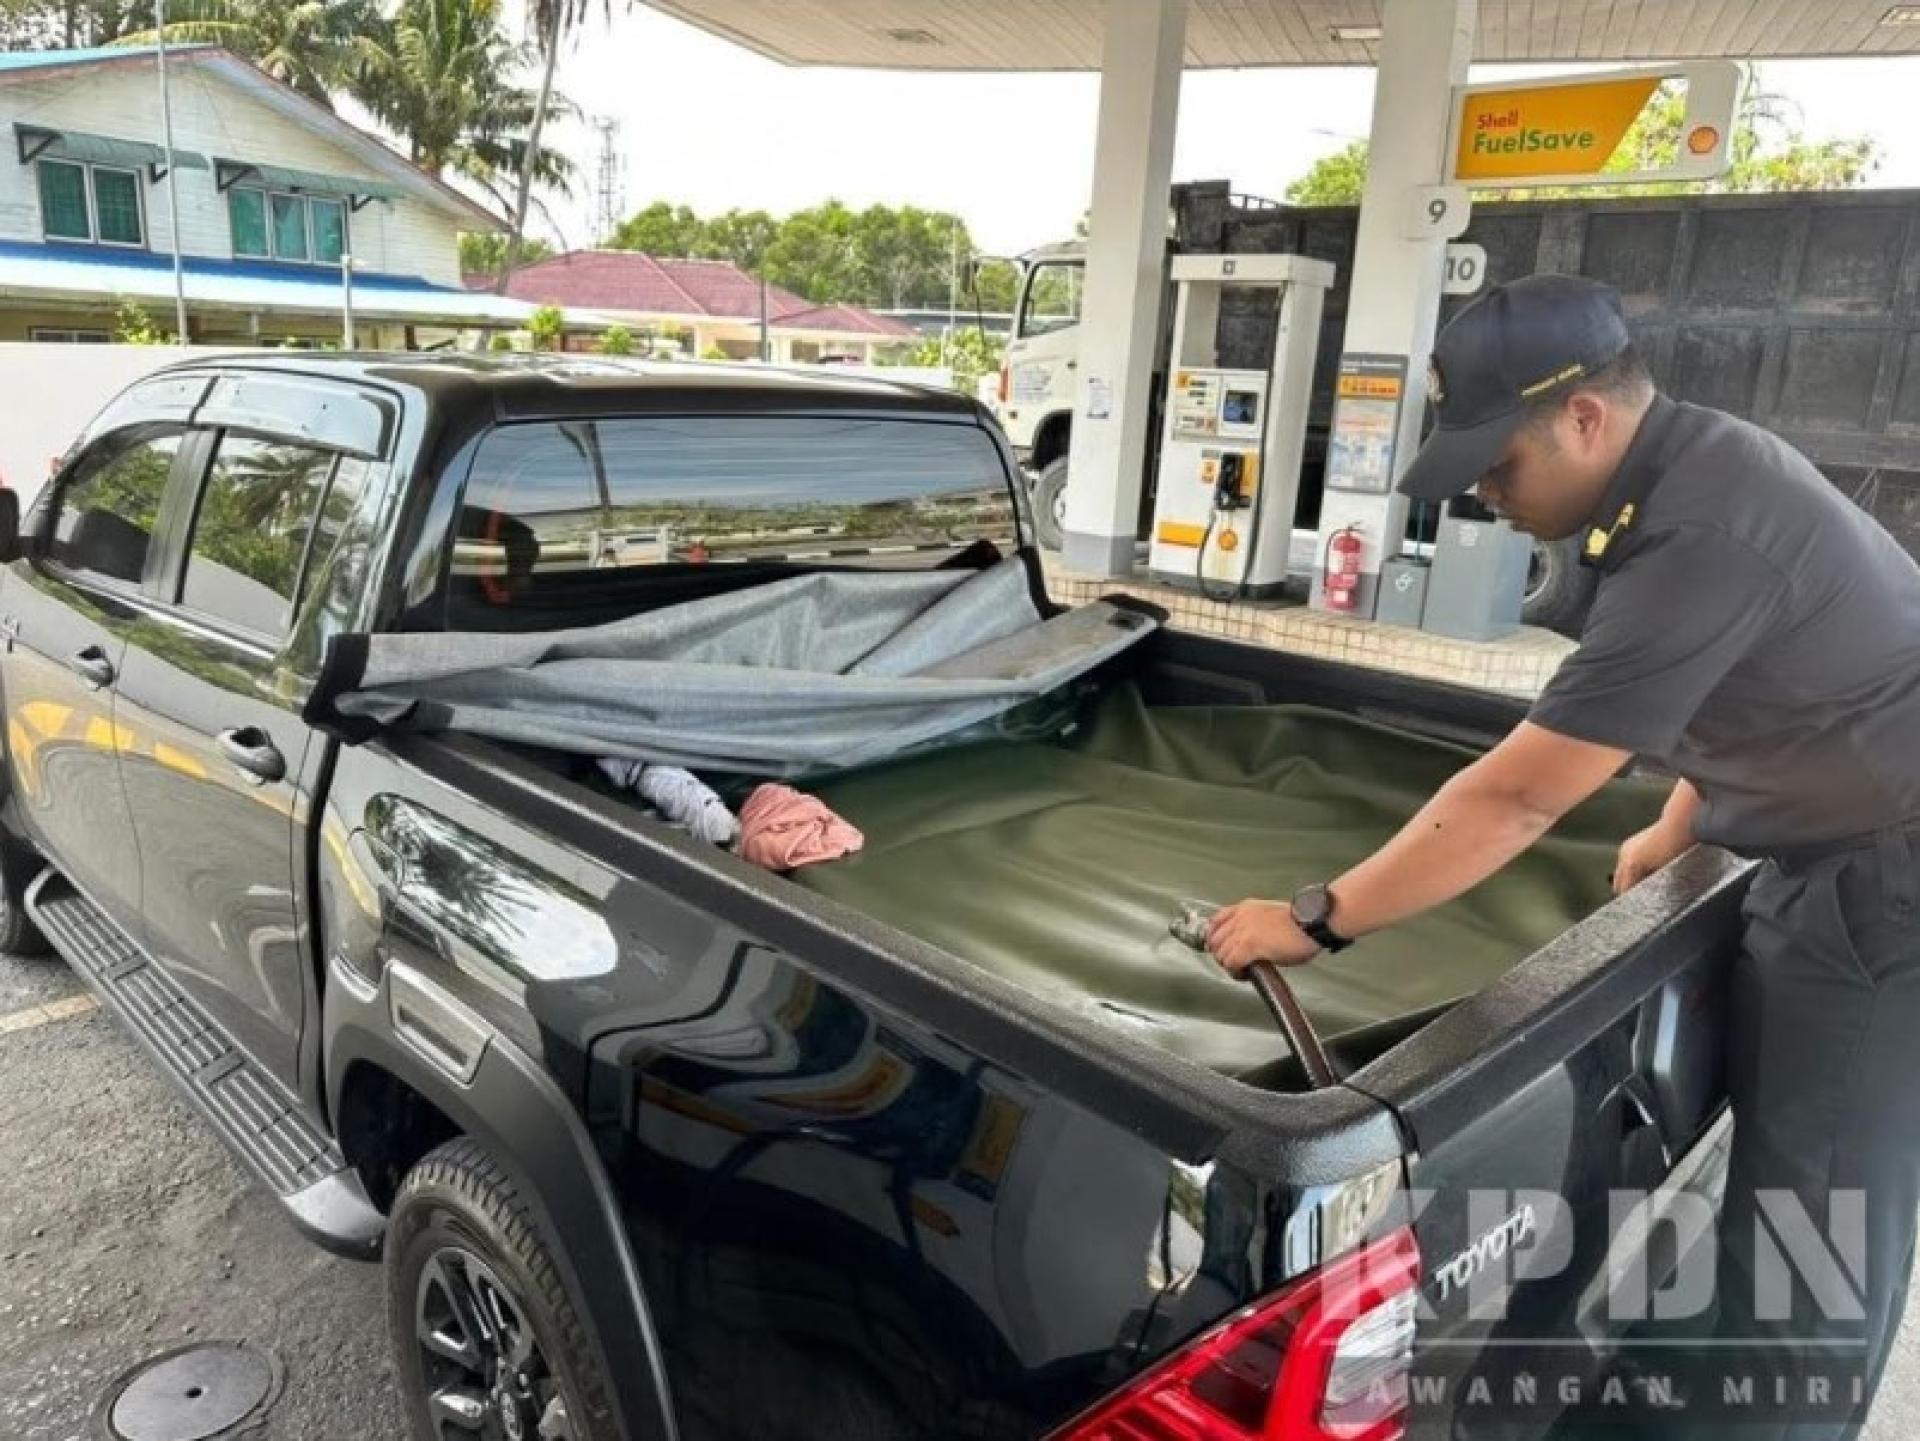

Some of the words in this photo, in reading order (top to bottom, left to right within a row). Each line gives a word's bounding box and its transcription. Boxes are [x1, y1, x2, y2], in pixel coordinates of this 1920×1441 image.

[1477, 109, 1519, 130] Shell
[1473, 127, 1593, 154] FuelSave
[1429, 198, 1447, 225] 9
[1446, 256, 1475, 281] 10
[1435, 1203, 1535, 1300] TOYOTA
